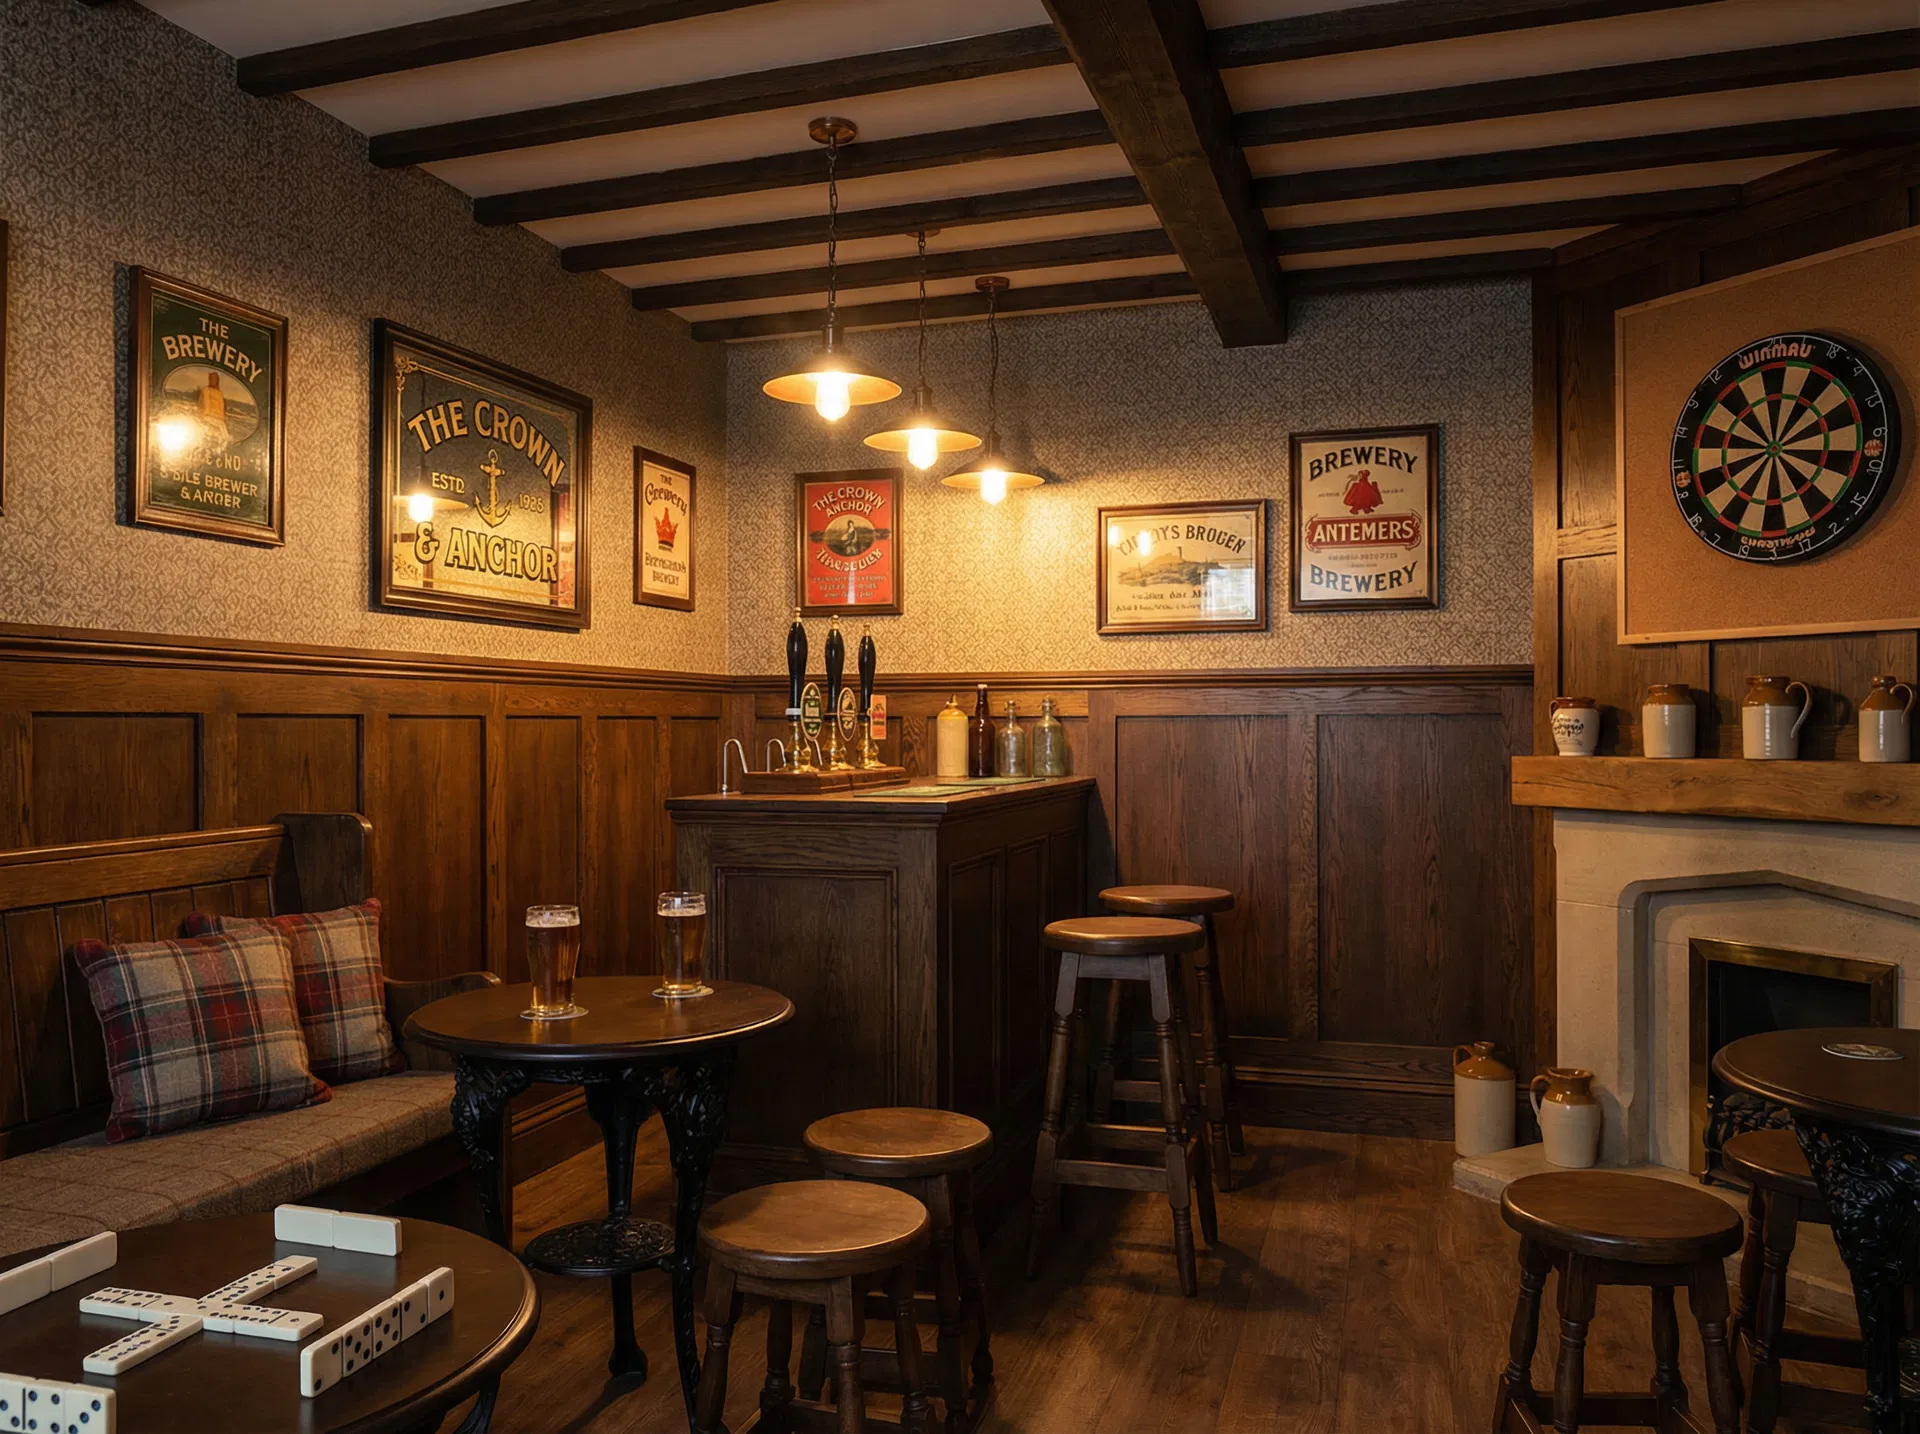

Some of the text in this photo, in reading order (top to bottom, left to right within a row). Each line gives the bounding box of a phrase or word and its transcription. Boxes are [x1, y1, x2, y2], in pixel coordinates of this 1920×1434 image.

[199, 317, 229, 339] THE
[161, 334, 263, 383] BREWERY
[1738, 343, 1812, 370] WINMAU
[1826, 344, 1841, 359] 18
[407, 400, 567, 488] THE CROWN
[1309, 446, 1418, 481] BREWERY
[205, 474, 257, 497] BREWER
[812, 487, 886, 511] THE CROWN
[825, 501, 872, 518] ANCHOR
[1312, 520, 1415, 543] ANTEMERS
[415, 522, 558, 583] & ANCHOR
[1310, 561, 1418, 593] BREWERY
